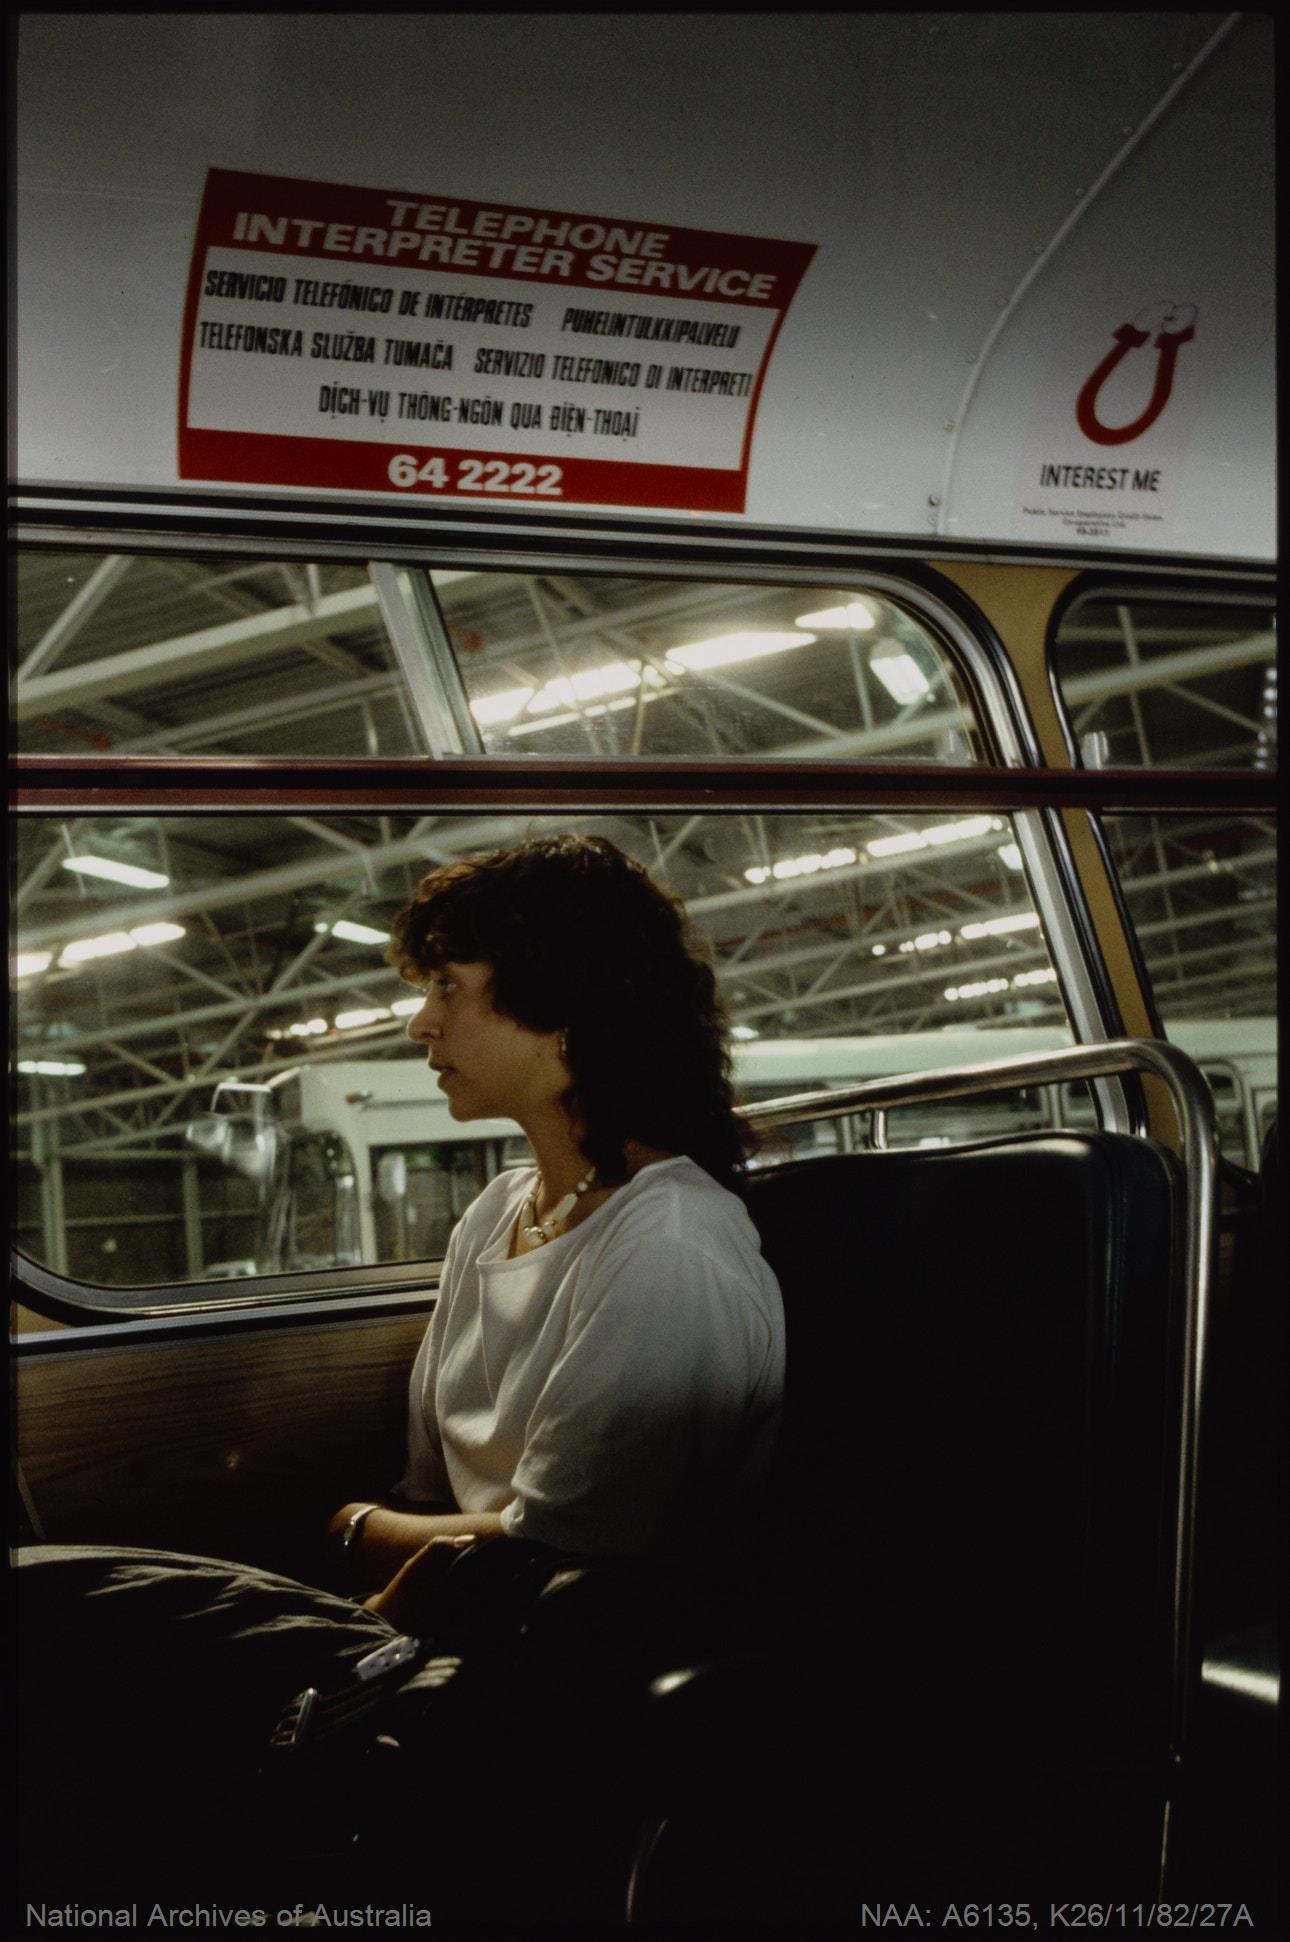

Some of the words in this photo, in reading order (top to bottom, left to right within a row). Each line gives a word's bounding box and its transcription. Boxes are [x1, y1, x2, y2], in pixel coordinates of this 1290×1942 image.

[387, 199, 670, 259] TELEPHONE
[232, 211, 576, 278] INTERPRETER
[585, 254, 778, 299] SERVICE
[204, 269, 287, 303] SERVICIO
[293, 278, 392, 315] TELEFÓNICO
[398, 290, 421, 317] DE
[424, 291, 535, 328] INTÉRPRETES
[200, 321, 304, 357] TELEFONSKA
[310, 330, 376, 364] SLUŽBA
[383, 338, 454, 371] TUMAČA
[561, 307, 742, 349] PUHELINTULKKIPALVELU
[474, 347, 547, 379] SERVIZIO
[552, 354, 641, 387] TELEFONICO
[645, 364, 663, 390] DI
[666, 366, 753, 398] INTERPRETI
[510, 401, 542, 431] QUA
[387, 454, 449, 489] 64
[456, 458, 563, 496] 2222
[1039, 463, 1129, 491] INTEREST
[1132, 468, 1162, 492] ME
